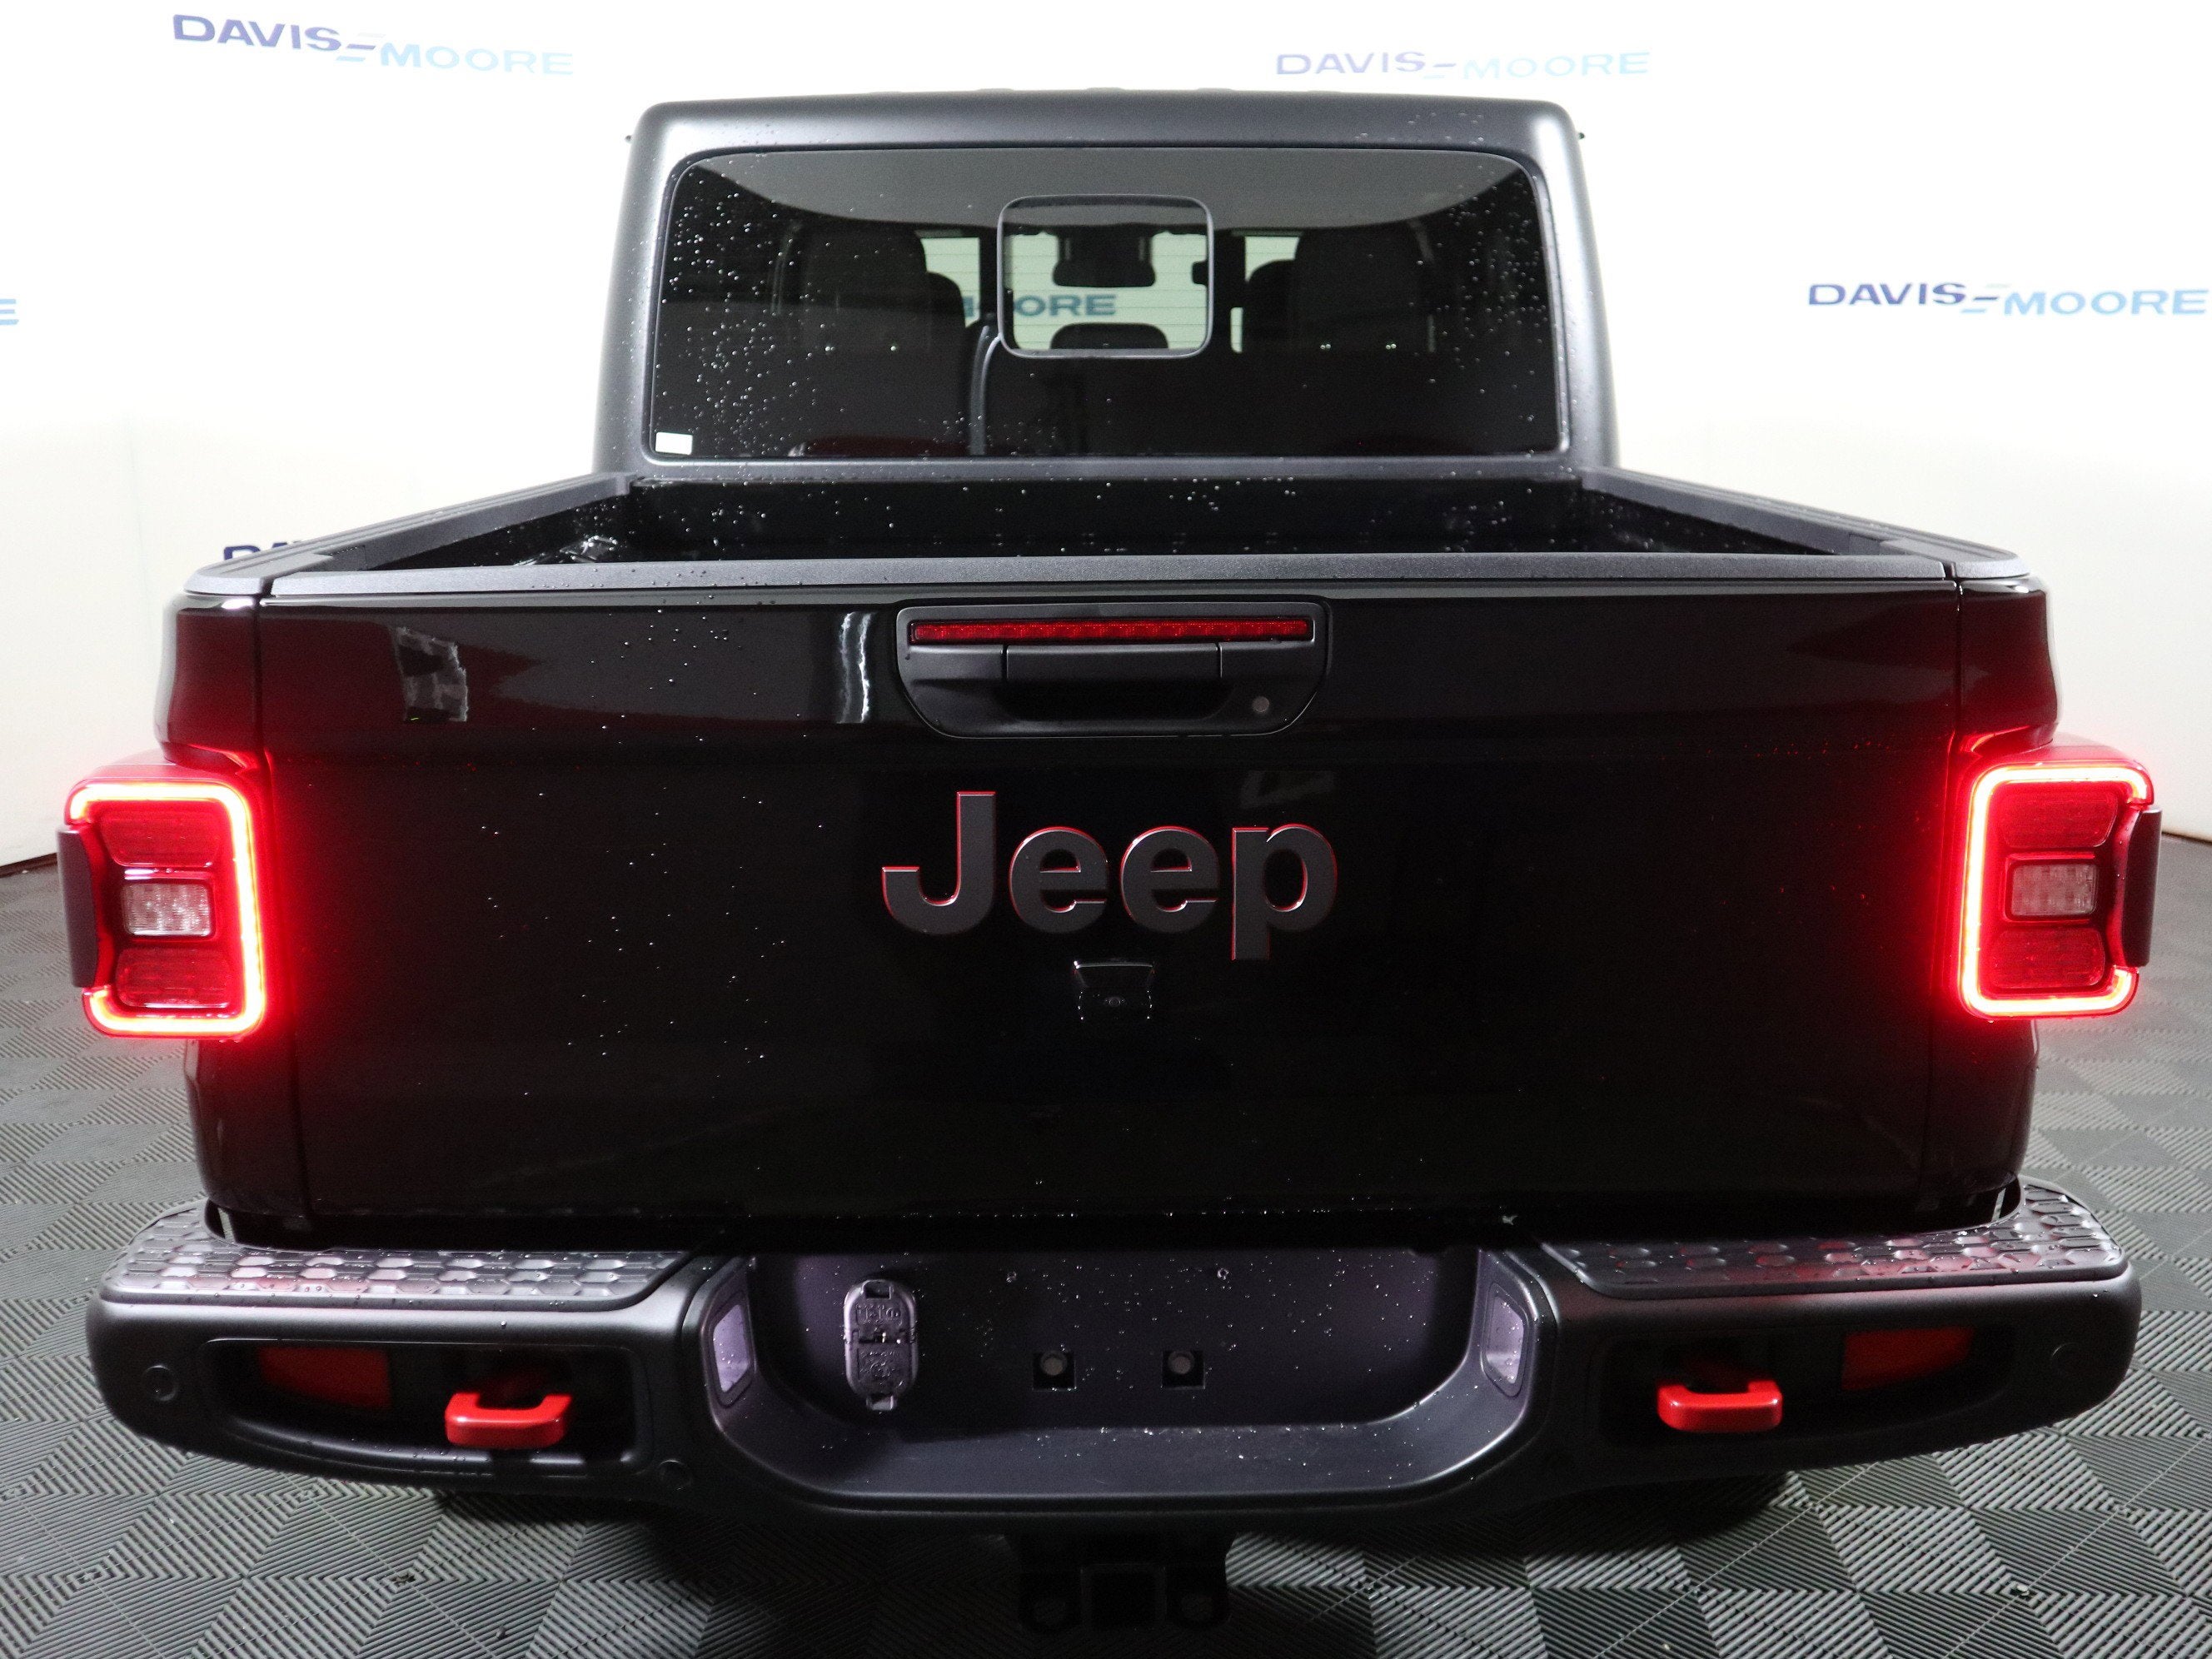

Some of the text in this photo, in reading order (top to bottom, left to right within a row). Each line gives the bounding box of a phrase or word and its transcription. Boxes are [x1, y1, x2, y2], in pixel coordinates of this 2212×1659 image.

[172, 13, 575, 76] DAVIS MOORE
[1275, 50, 1651, 80] DAVIS MOORE
[1807, 281, 2210, 317] DAVIS MOORE
[881, 790, 1339, 961] Jeep
